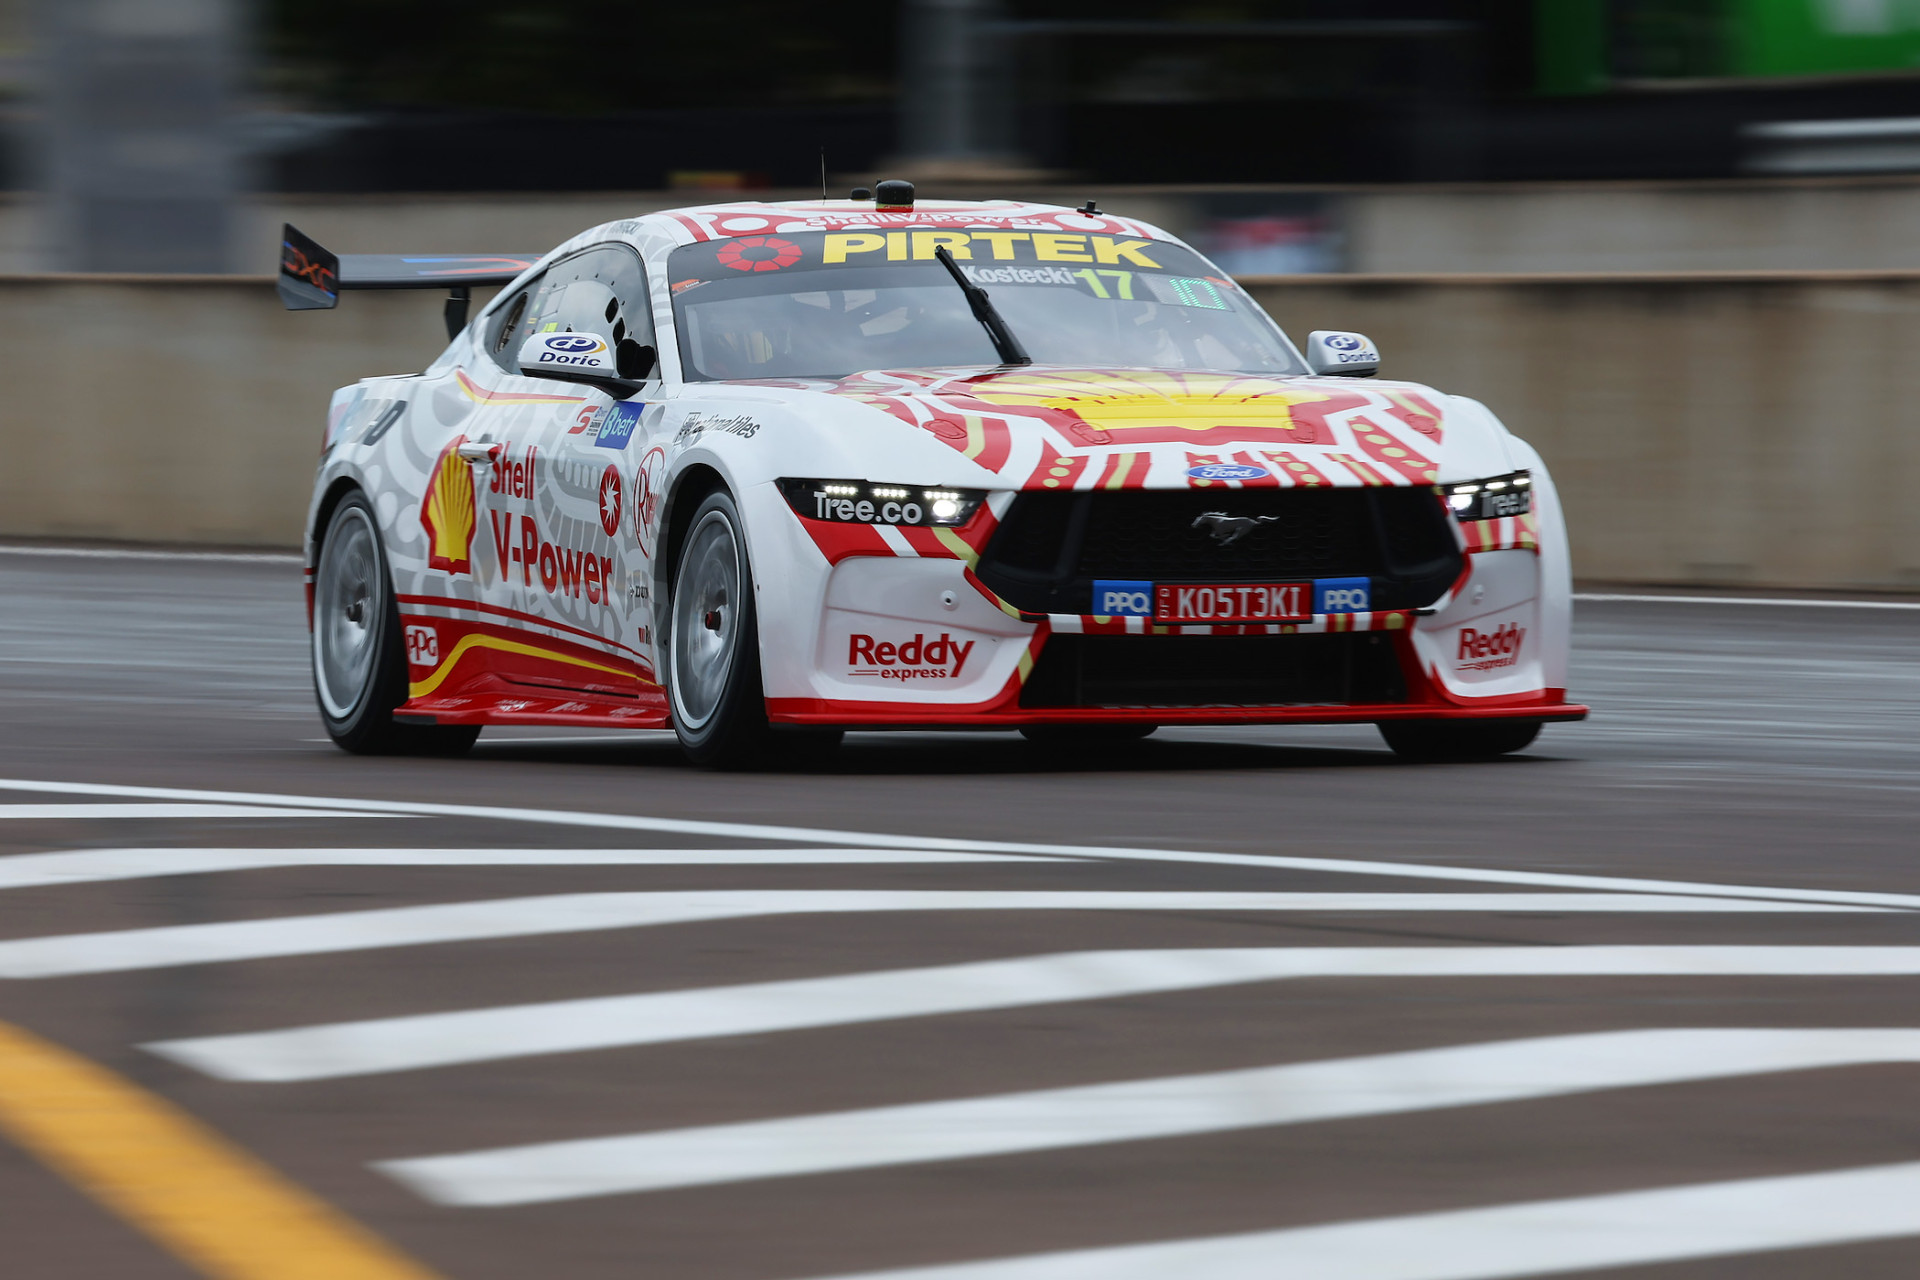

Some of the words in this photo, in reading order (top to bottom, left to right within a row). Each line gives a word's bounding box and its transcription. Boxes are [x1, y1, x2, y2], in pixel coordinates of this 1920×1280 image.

[806, 213, 882, 227] Shell
[822, 231, 1163, 269] PIRTEK
[959, 265, 1077, 285] Kostecki
[1072, 268, 1135, 300] 17
[539, 352, 601, 367] Doric
[611, 411, 635, 437] betr
[490, 441, 538, 501] Shell
[1201, 466, 1255, 478] Ford
[813, 491, 923, 525] Tree.co
[490, 508, 613, 607] V-Power
[1103, 591, 1150, 613] PPQ
[1324, 588, 1369, 611] PPQ
[406, 628, 437, 661] PPG
[848, 632, 976, 678] Reddy
[1457, 621, 1528, 666] Reddy
[881, 668, 948, 682] express
